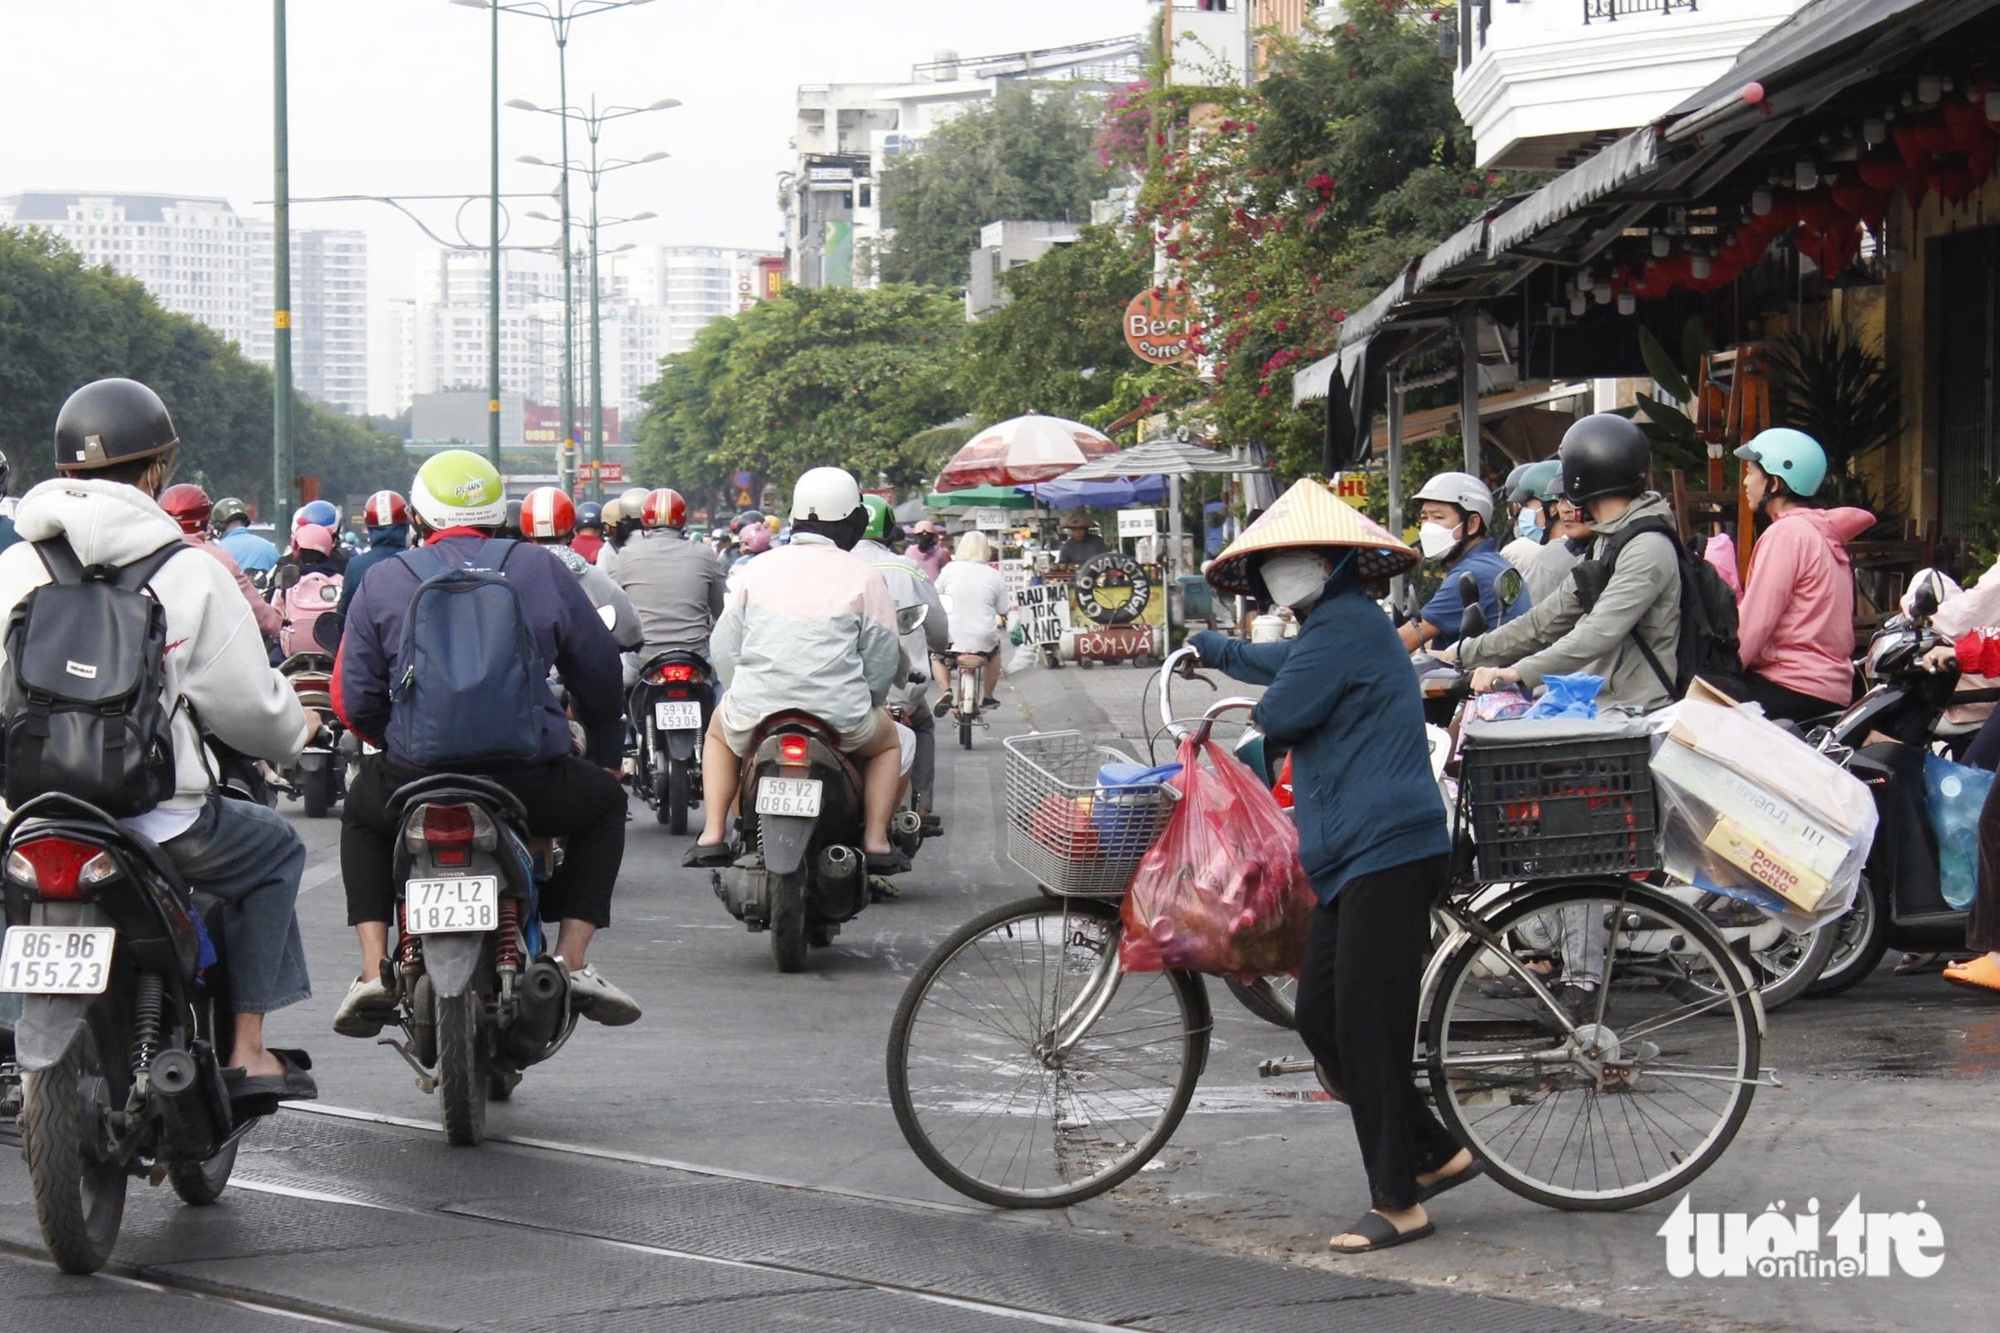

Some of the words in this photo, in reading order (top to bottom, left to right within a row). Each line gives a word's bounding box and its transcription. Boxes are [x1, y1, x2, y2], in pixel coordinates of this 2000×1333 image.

[1139, 339, 1188, 358] coffee
[1016, 588, 1043, 606] RAU
[663, 704, 694, 716] 59-V2
[661, 715, 698, 728] 453.06
[769, 781, 813, 798] 59-V2
[760, 797, 815, 813] 086.44
[1751, 848, 1799, 885] Panna
[1749, 861, 1789, 894] Cotta
[420, 881, 483, 905] 77-L2
[413, 904, 491, 930] 182.38
[22, 932, 96, 959] 86-B6
[10, 961, 102, 988] 155.23
